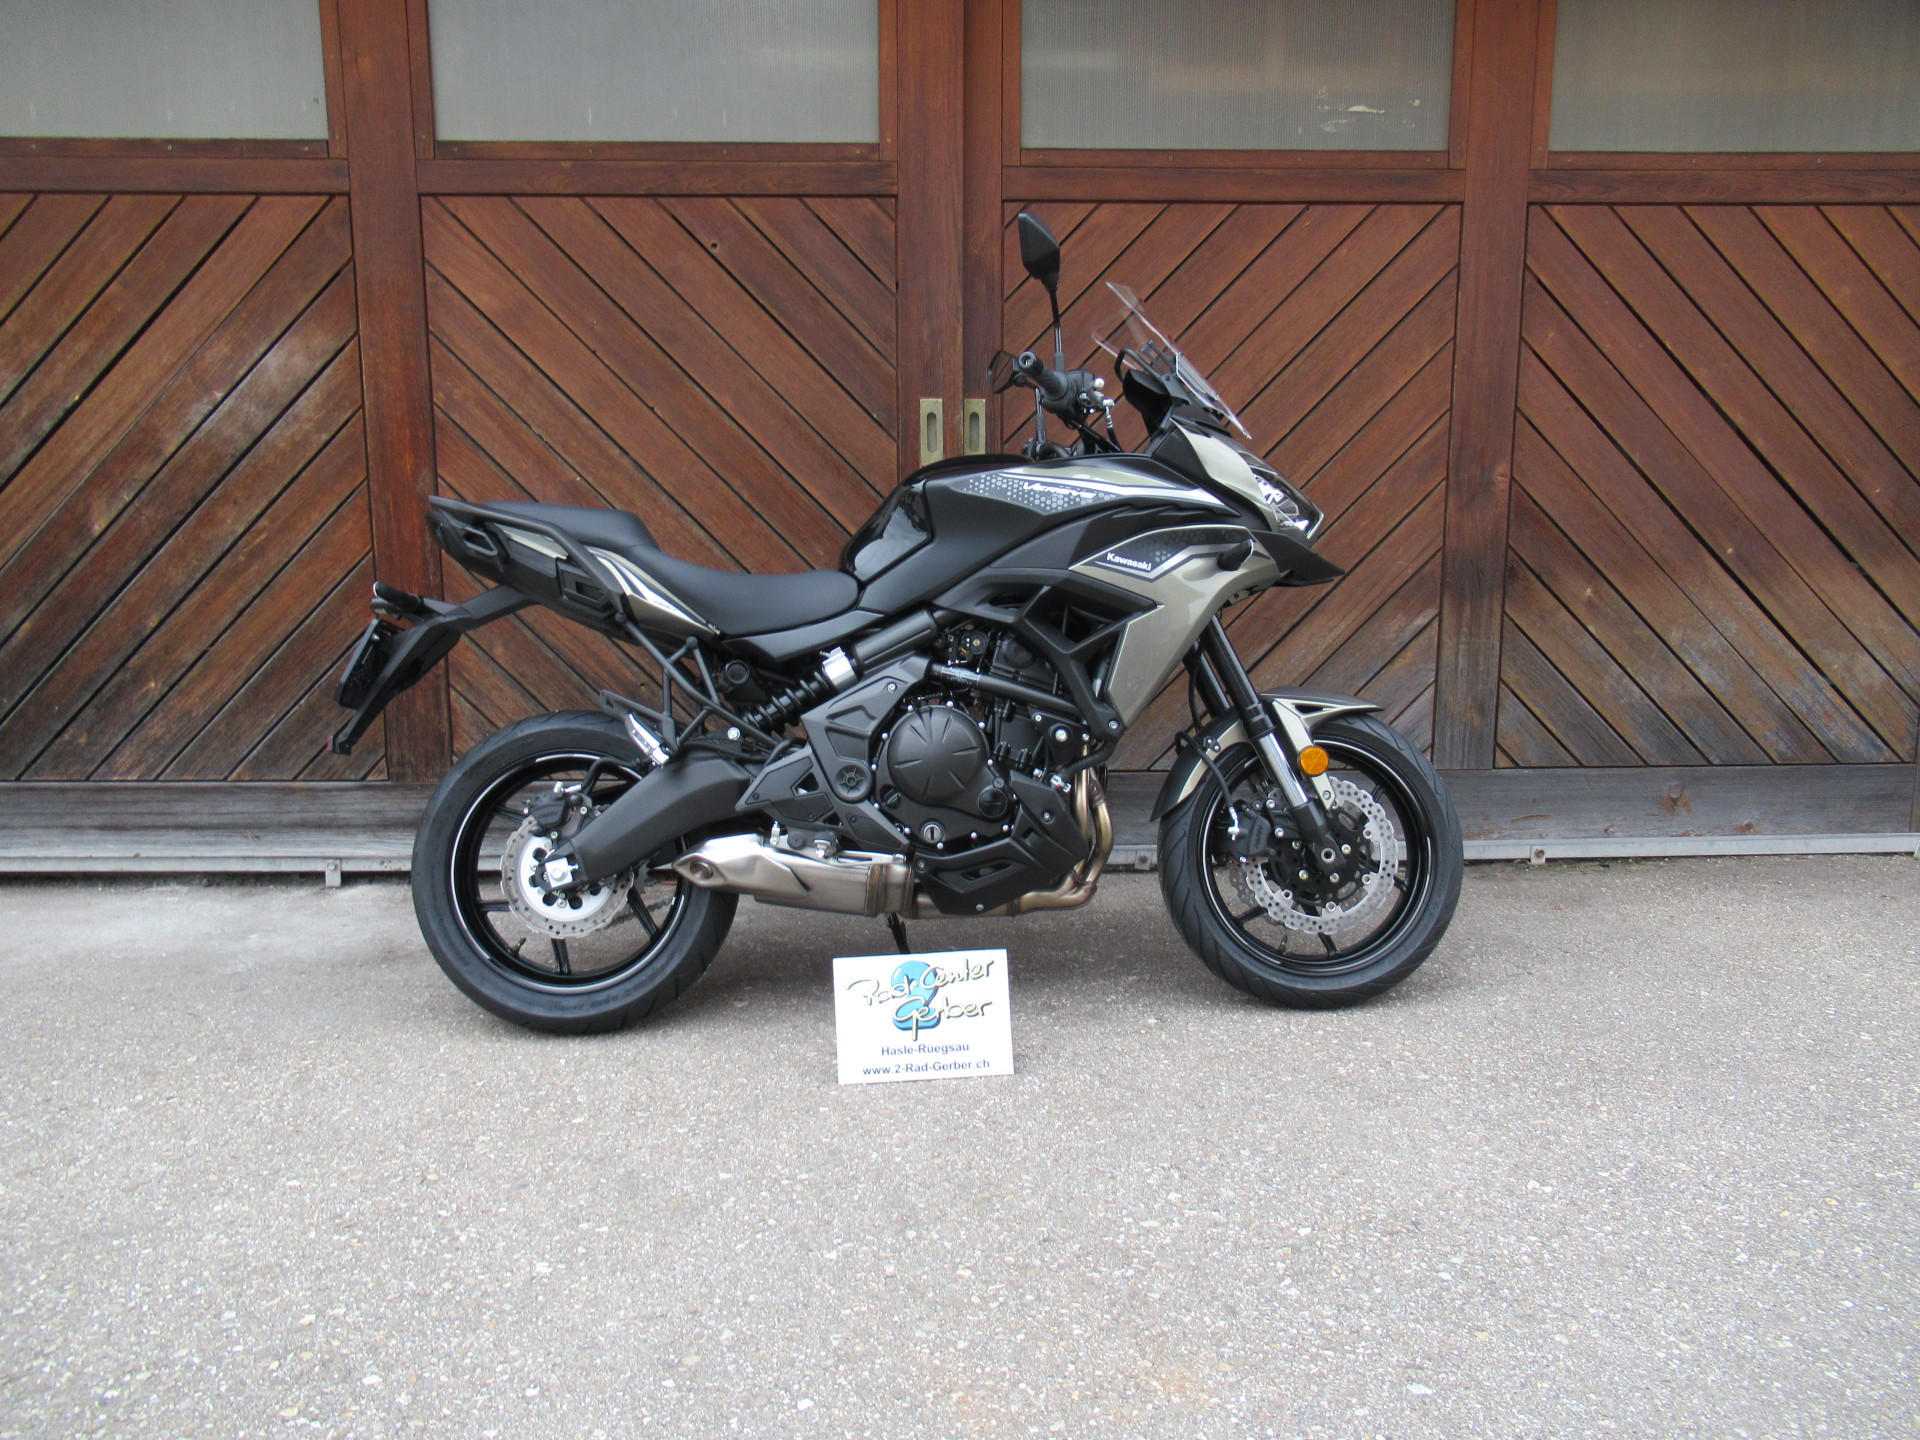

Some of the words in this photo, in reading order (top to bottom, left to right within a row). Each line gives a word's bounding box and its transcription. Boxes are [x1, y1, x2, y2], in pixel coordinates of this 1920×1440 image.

[1106, 552, 1152, 571] Kawasaki
[919, 957, 995, 990] Center
[892, 995, 993, 1042] Gerber
[881, 1042, 970, 1057] Hasle-Rüegsau
[862, 1058, 991, 1076] www.2-Rad-Gerber.ch
